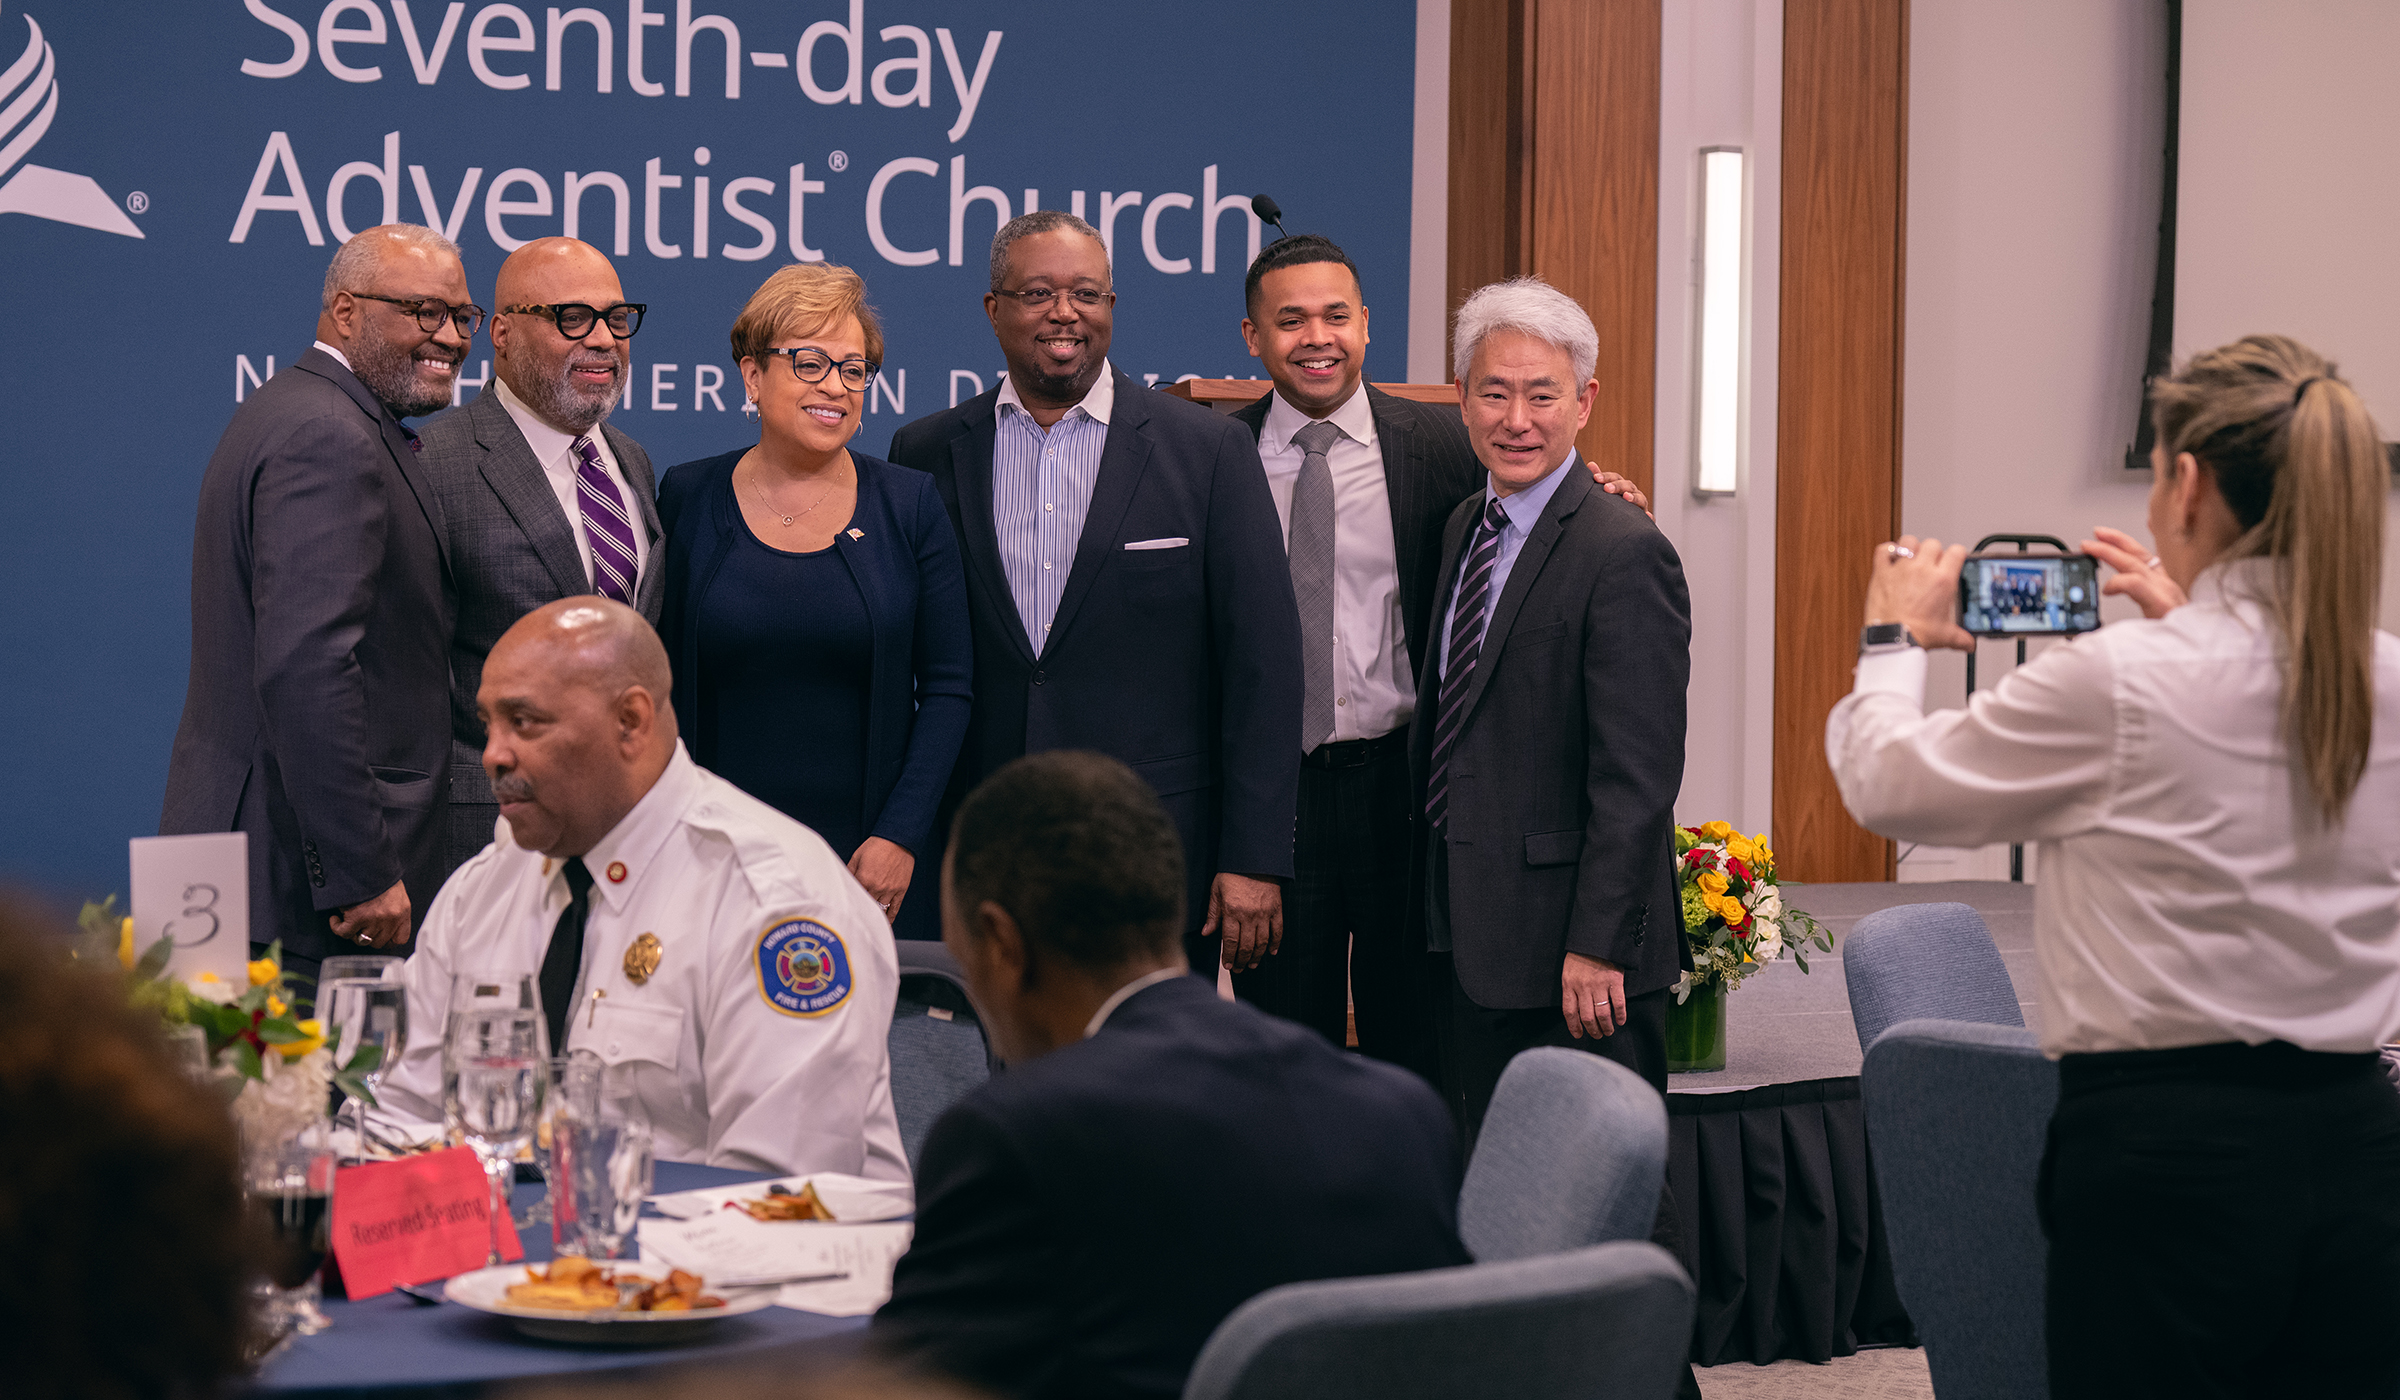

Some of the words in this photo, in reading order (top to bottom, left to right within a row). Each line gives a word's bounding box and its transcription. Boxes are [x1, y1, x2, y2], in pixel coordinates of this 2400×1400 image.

[240, 0, 1003, 143] Seventh-day
[161, 882, 221, 949] 3
[764, 923, 799, 950] HOWARD
[800, 923, 836, 943] COUNTY
[775, 992, 799, 1009] FIRE
[810, 984, 846, 1009] RESCUE
